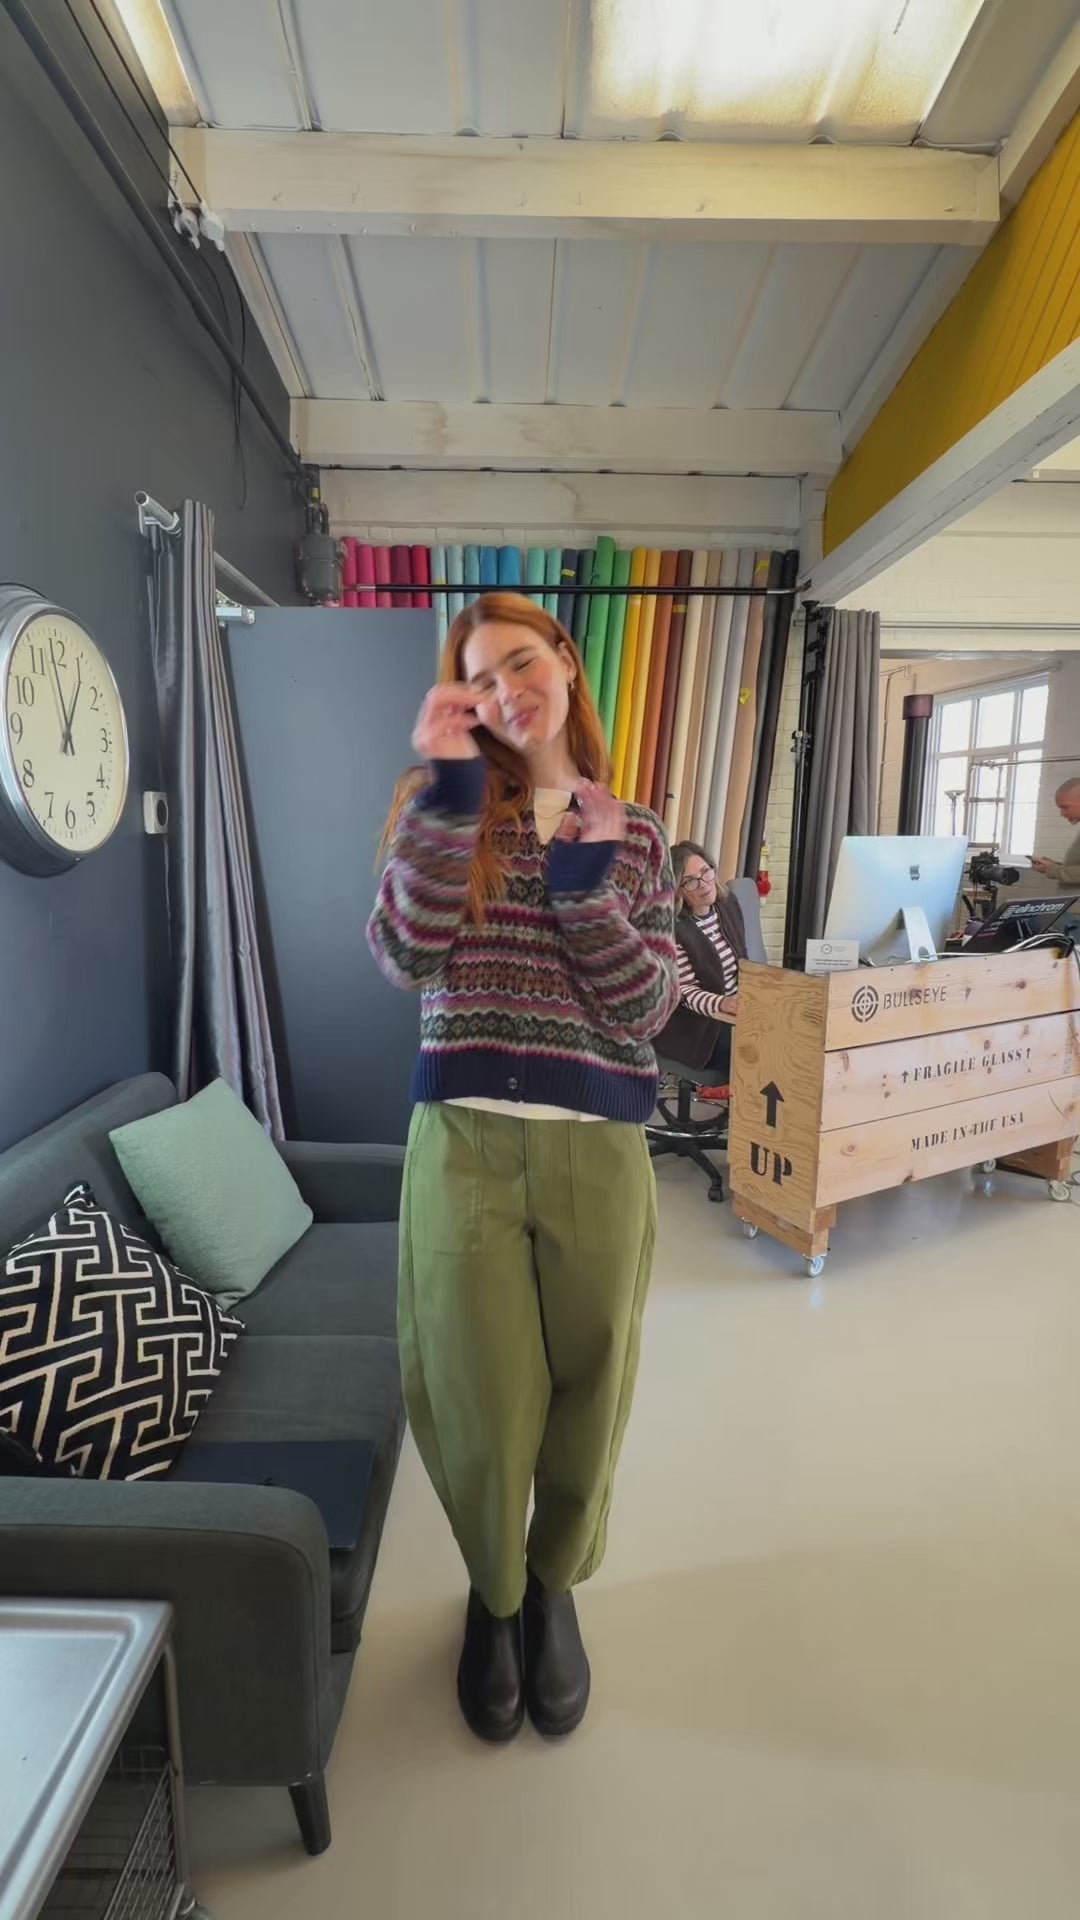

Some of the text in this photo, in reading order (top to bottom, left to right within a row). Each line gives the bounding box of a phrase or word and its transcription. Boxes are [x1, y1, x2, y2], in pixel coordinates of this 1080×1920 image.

[28, 644, 46, 677] 11
[48, 637, 67, 669] 12
[14, 674, 35, 707] 10
[89, 685, 99, 712] 2
[10, 711, 23, 745] 9
[99, 727, 109, 753] 3
[22, 758, 35, 788] 8
[96, 763, 105, 789] 4
[44, 791, 54, 819] 7
[64, 799, 76, 830] 6
[86, 791, 96, 818] 5
[1014, 902, 1066, 914] elinchrom
[883, 985, 948, 1010] BULLSEYE
[913, 1048, 1023, 1082] FRAGILE GLASS
[910, 1111, 1024, 1152] MADE IN THE USA
[750, 1140, 793, 1186] UP
